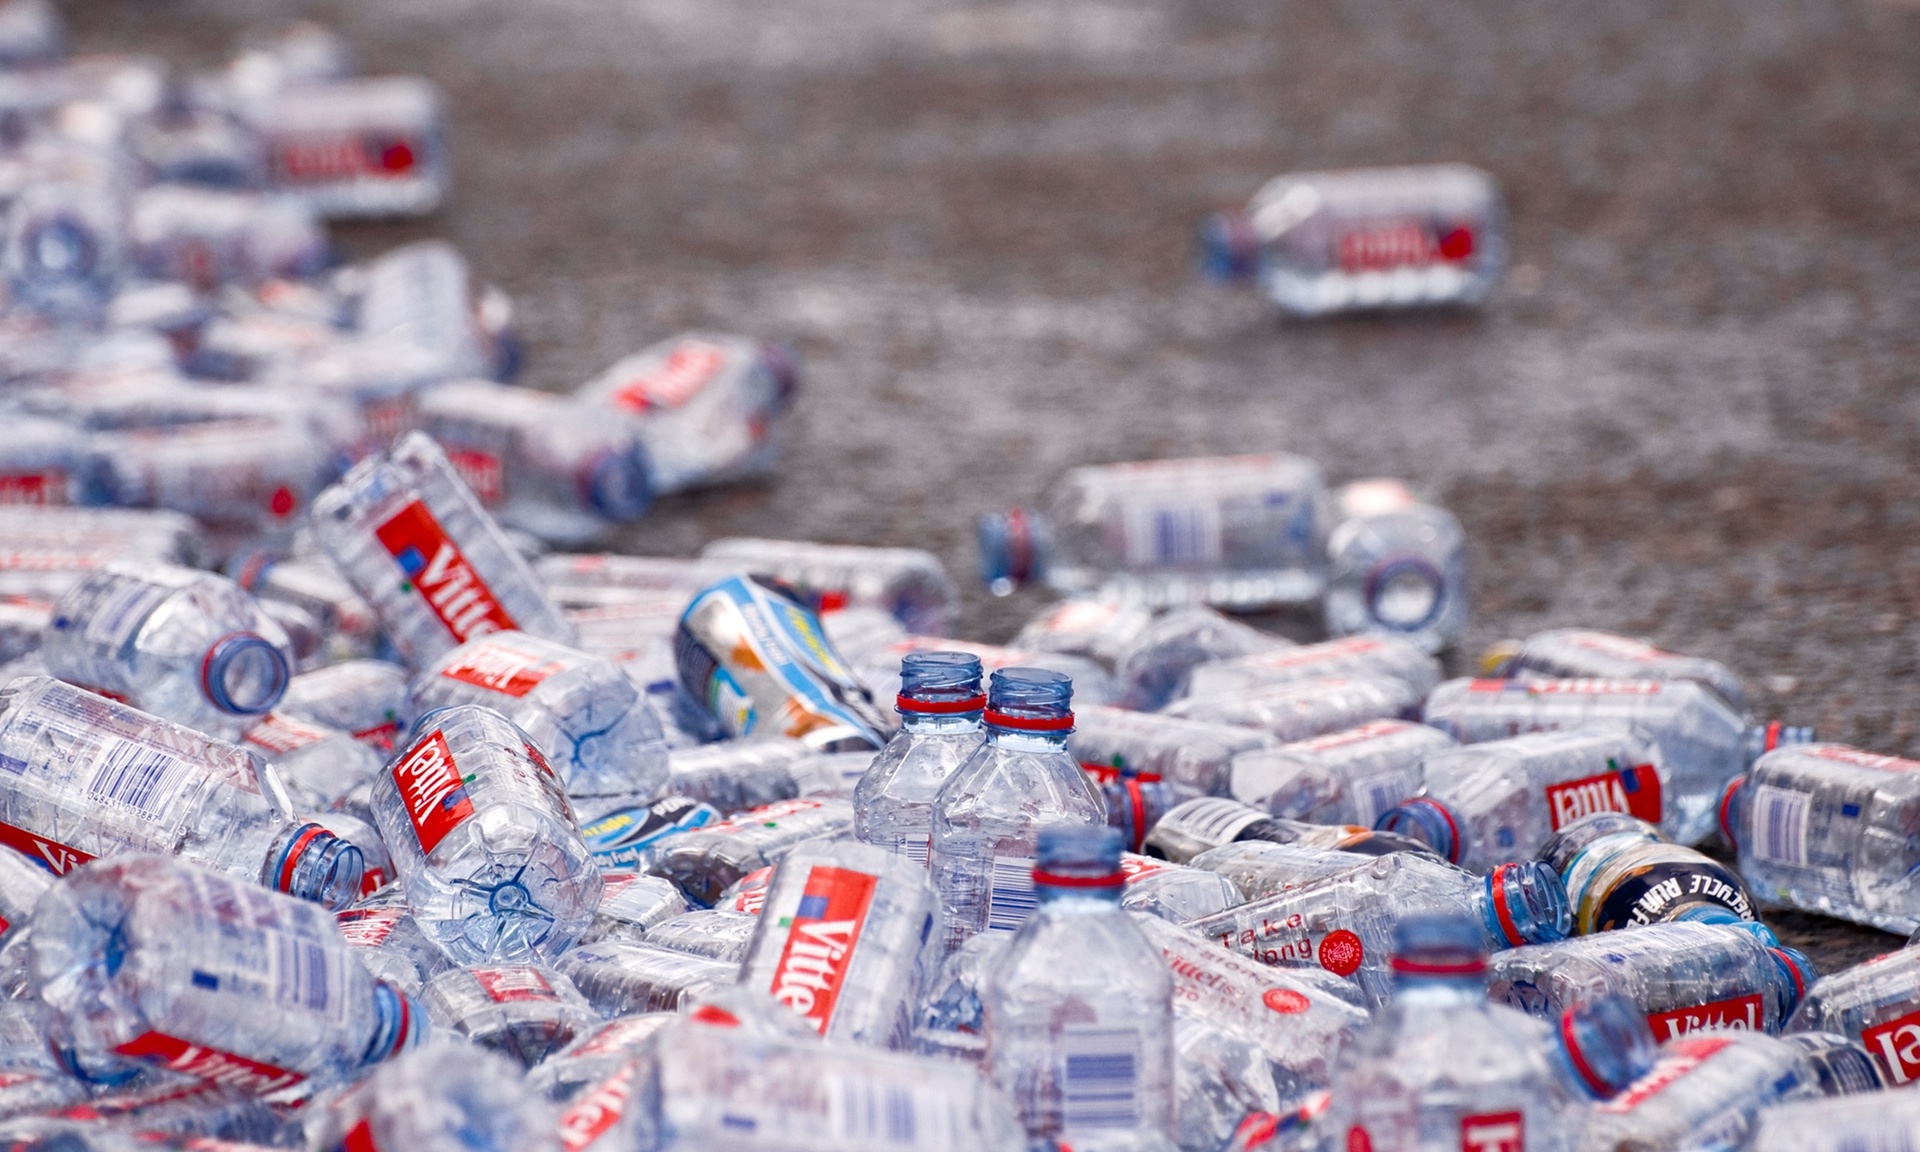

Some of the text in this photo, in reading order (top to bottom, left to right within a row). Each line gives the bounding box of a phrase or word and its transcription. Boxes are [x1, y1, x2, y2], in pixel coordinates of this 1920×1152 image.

[420, 544, 502, 641] Vitte
[399, 737, 455, 827] Vittel
[1638, 877, 1683, 915] RUN
[1688, 874, 1755, 921] RECYCLE
[1217, 912, 1302, 949] Take
[1253, 937, 1313, 965] long
[775, 920, 857, 1030] Vitte
